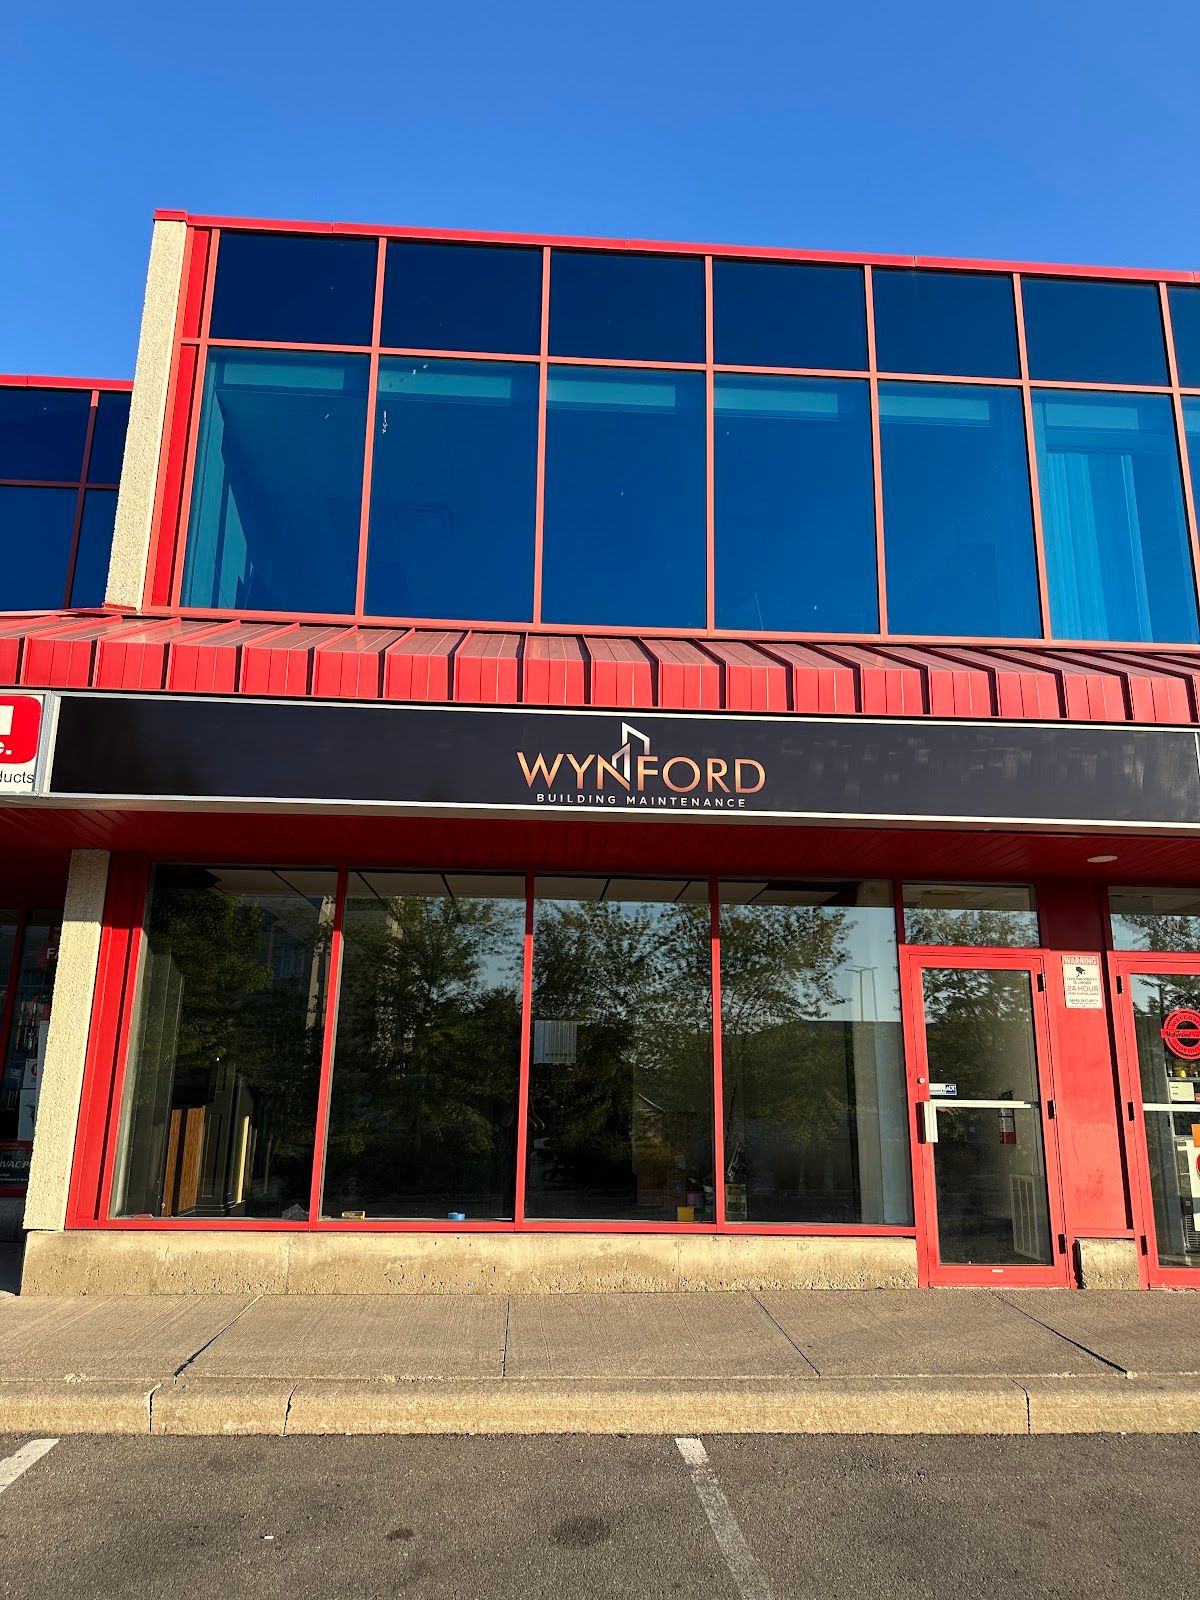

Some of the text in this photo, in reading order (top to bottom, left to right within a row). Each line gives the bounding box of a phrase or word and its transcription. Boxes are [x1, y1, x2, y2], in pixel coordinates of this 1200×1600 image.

[0, 770, 35, 784] ucts
[516, 751, 767, 794] WYNFORD
[536, 793, 747, 808] BUILDING MAINTENANCE
[1063, 956, 1097, 965] WARNING
